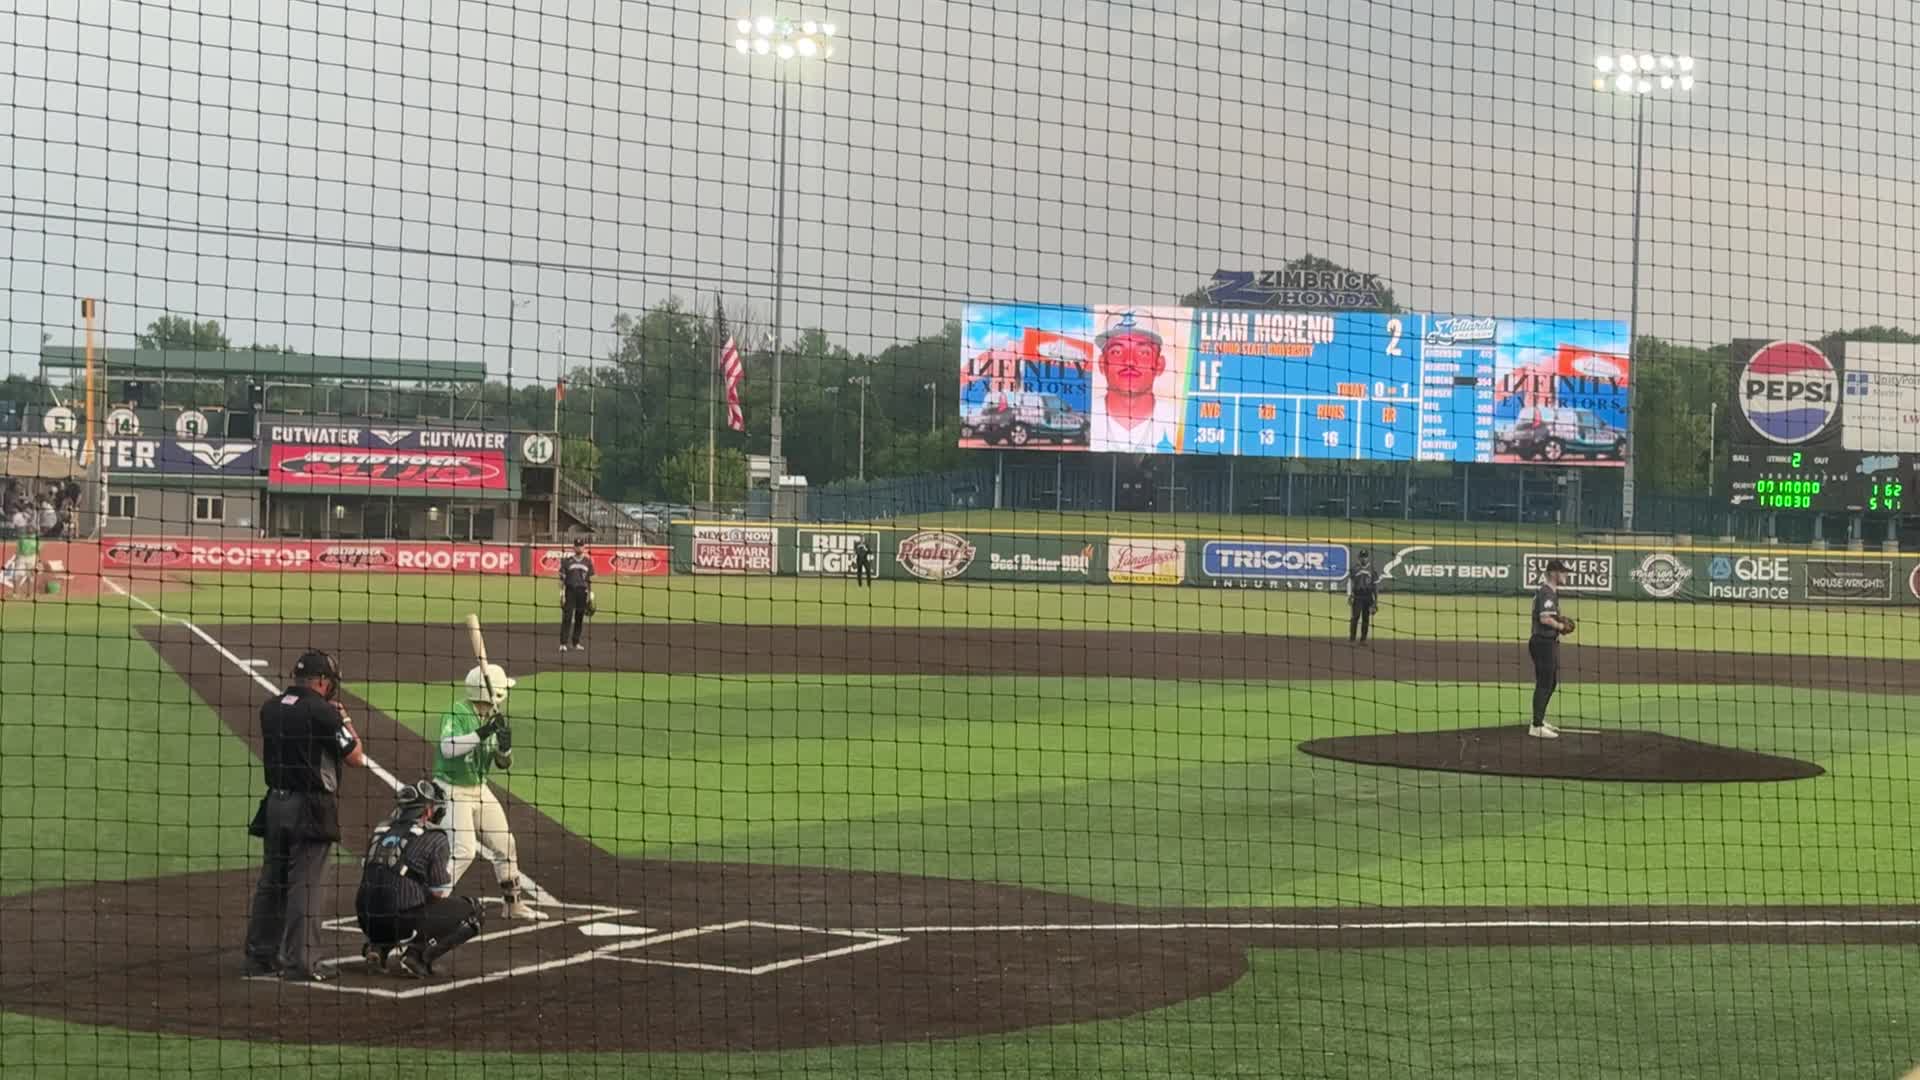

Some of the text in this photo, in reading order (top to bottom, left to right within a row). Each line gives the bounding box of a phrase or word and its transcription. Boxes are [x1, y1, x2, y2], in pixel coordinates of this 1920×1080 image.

[1258, 271, 1379, 290] ZIMBRICK
[1279, 291, 1382, 308] HONDA
[1200, 312, 1334, 344] LIAM MORENO
[1386, 319, 1403, 356] 2
[1199, 360, 1223, 390] LF
[1746, 380, 1833, 402] PEPSI
[54, 416, 65, 432] 5
[115, 418, 131, 435] 14
[186, 419, 200, 435] 9
[272, 427, 360, 445] CUTWATER
[420, 431, 506, 449] CUTWATER
[527, 440, 547, 459] 41
[1792, 452, 1802, 468] 2
[745, 531, 770, 541] NOW
[192, 546, 310, 566] ROOFTOP
[700, 545, 769, 557] FIRST WARN
[1216, 549, 1328, 570] TRICOR
[398, 552, 514, 569] ROOFTOP
[699, 555, 770, 568] WEATHER
[990, 553, 1089, 575] Beef Butter BBQ
[1528, 558, 1609, 574] SUMERS
[1735, 556, 1790, 582] QBE
[1404, 563, 1509, 579] WEST BEND
[1528, 572, 1608, 586] PATING
[1213, 579, 1338, 590] INSURANCE
[1709, 582, 1790, 600] Insurance
